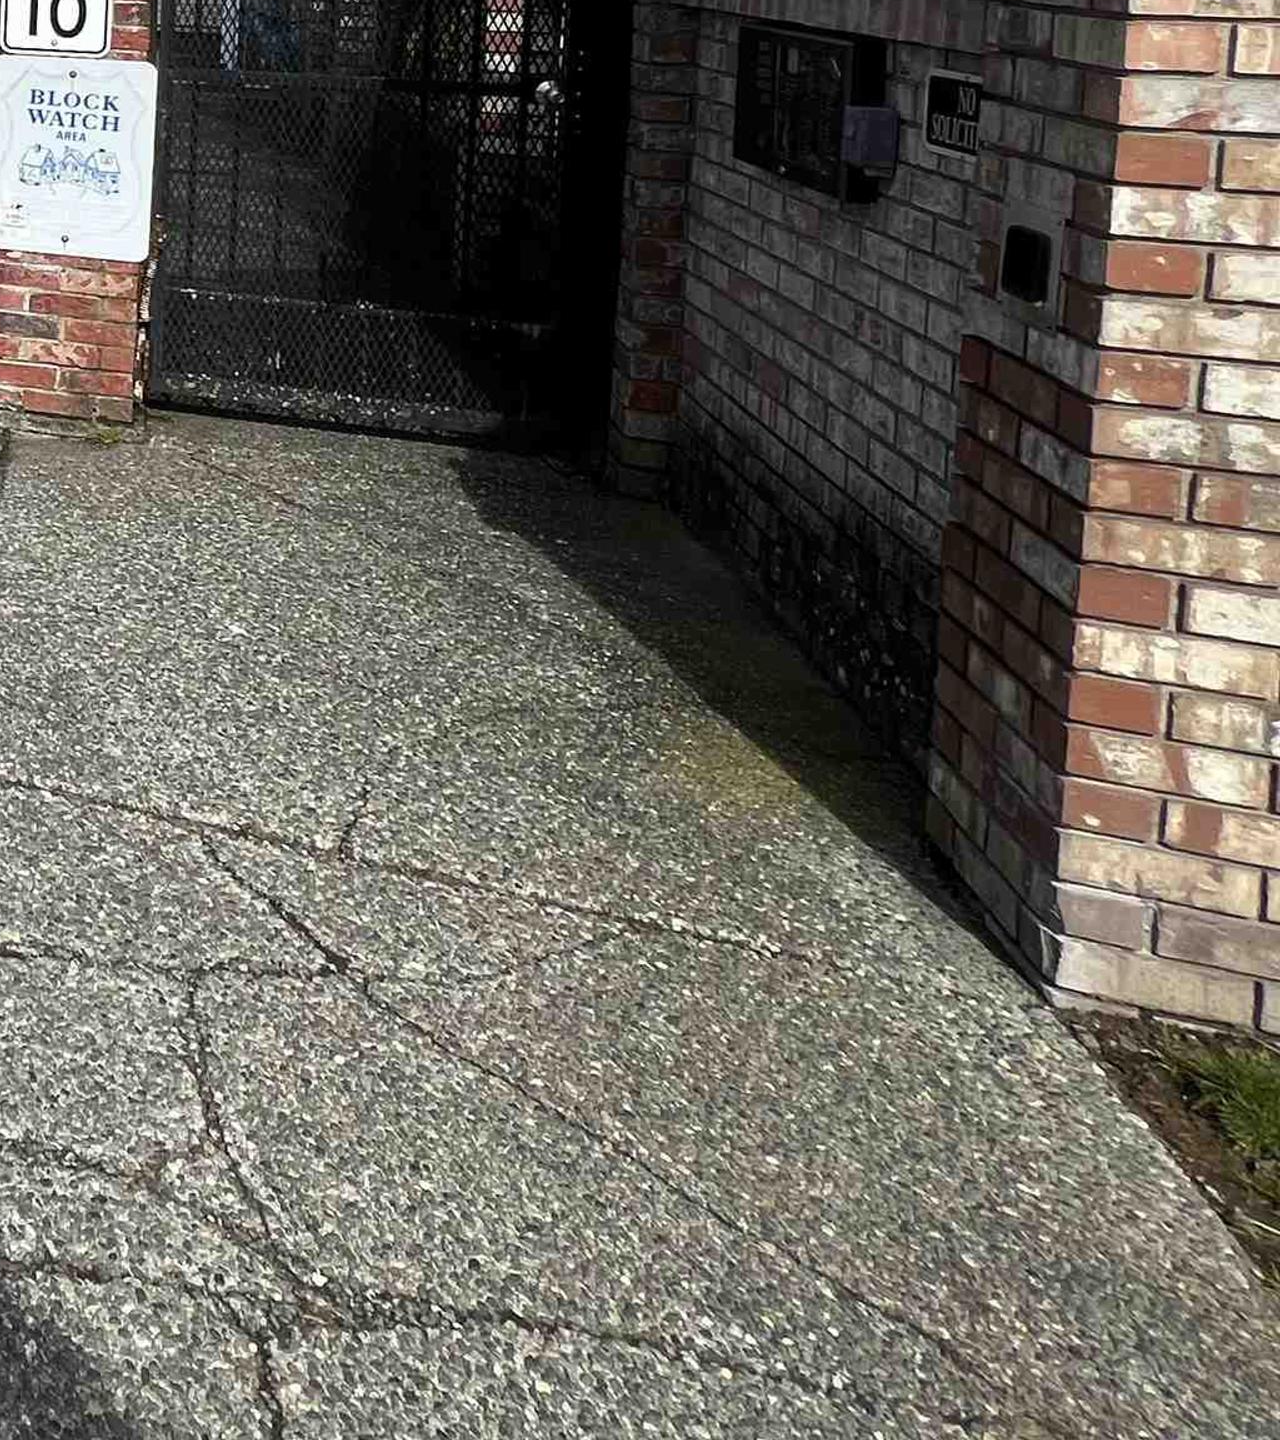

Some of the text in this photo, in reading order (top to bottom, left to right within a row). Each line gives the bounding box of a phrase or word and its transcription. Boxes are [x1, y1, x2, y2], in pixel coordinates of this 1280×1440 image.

[30, 88, 119, 112] BLOCK
[957, 86, 976, 116] NO
[27, 108, 120, 132] WATCH
[56, 130, 87, 142] AREA
